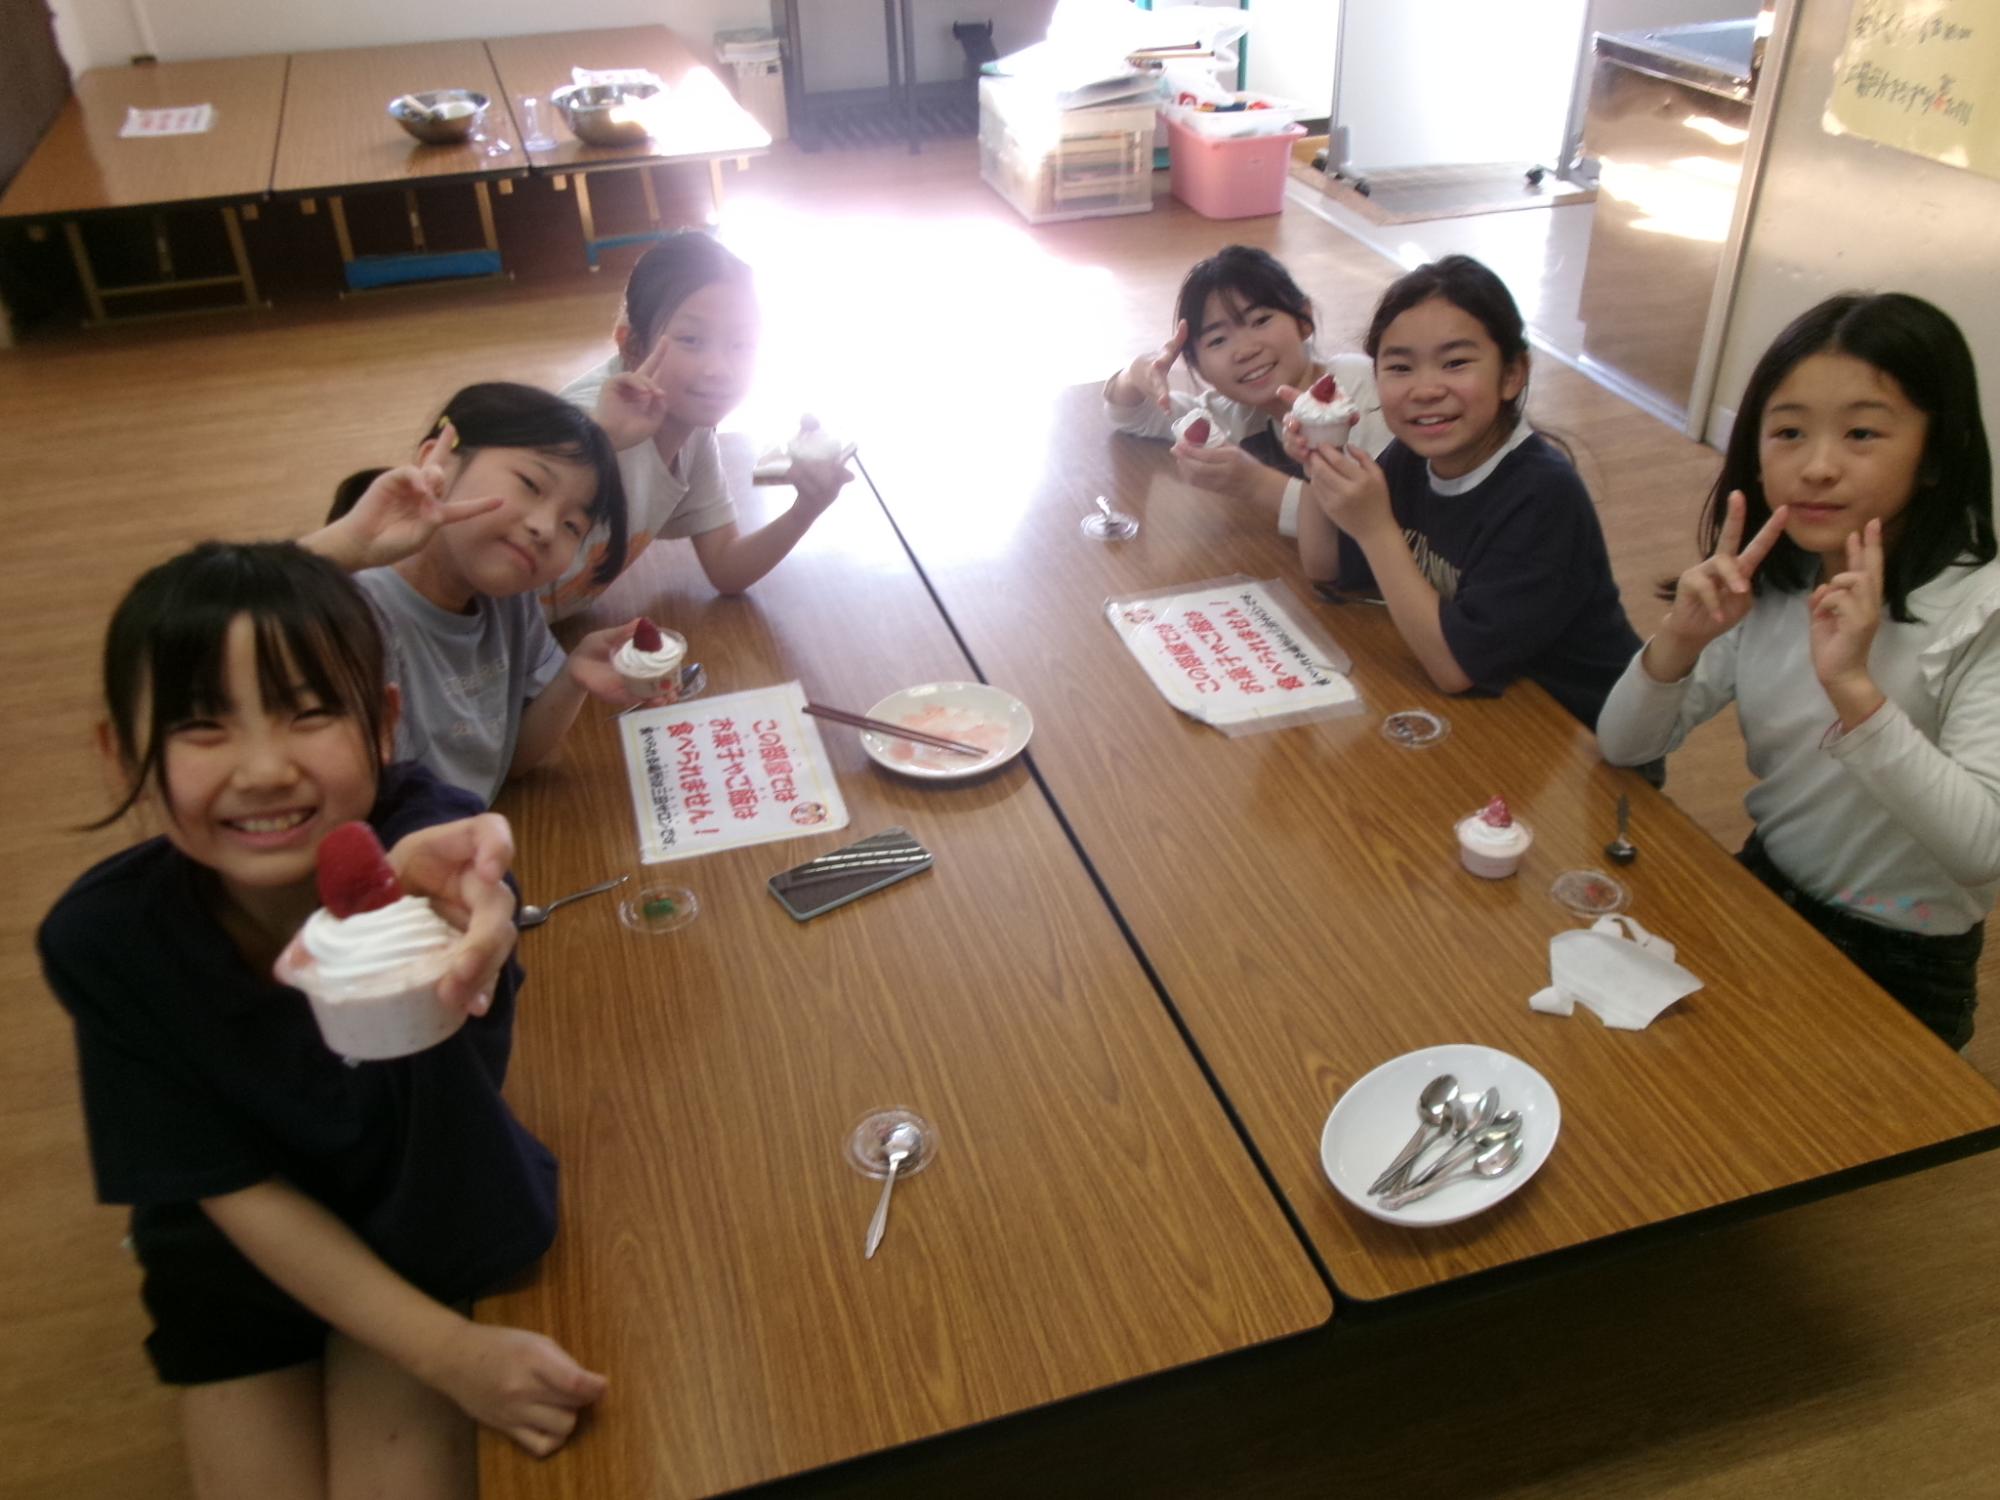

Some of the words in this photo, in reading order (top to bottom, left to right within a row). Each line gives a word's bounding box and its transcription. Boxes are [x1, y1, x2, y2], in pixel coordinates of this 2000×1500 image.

[1155, 623, 1221, 693] この部屋では
[709, 717, 759, 821] お菓子やご飯は
[753, 720, 798, 804] この部屋では
